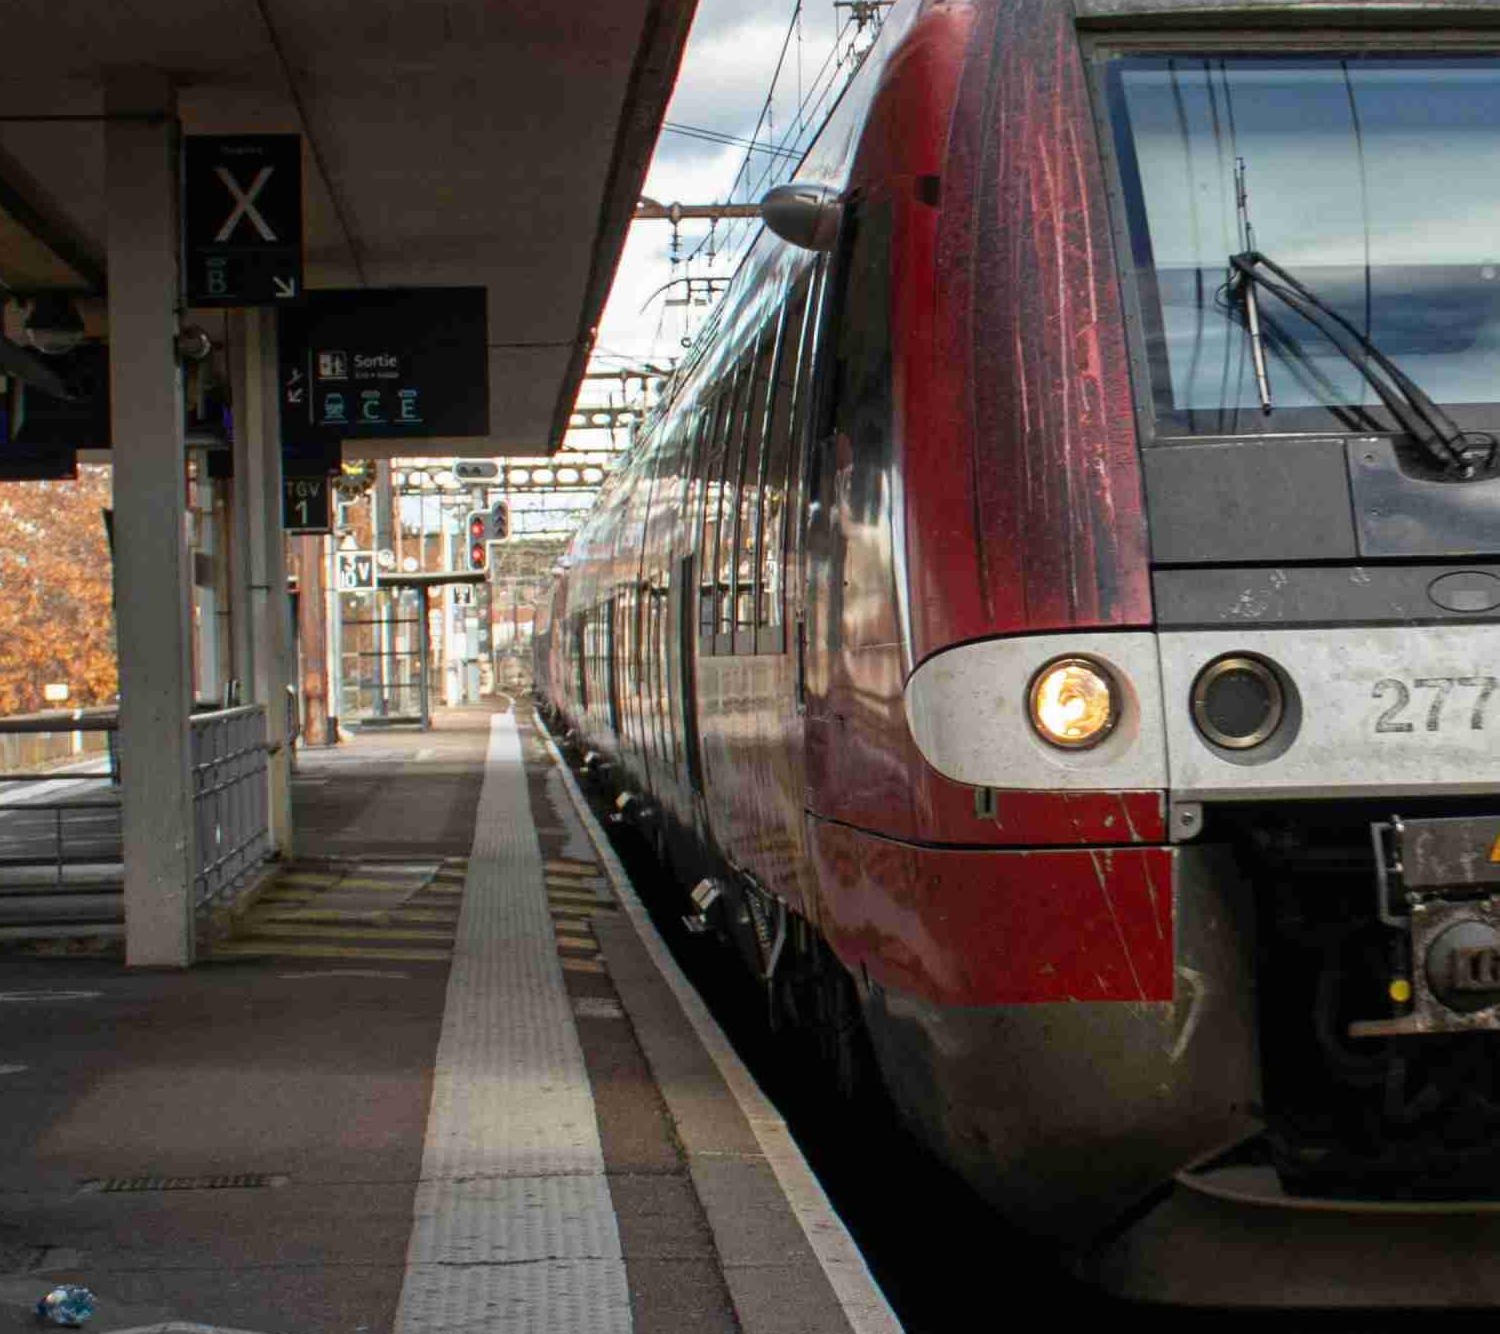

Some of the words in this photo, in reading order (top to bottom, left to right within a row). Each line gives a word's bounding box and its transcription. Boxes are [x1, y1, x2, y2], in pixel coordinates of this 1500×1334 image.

[213, 165, 278, 242] X
[353, 353, 397, 368] Sortie
[362, 400, 381, 420] C
[401, 399, 417, 419] E
[286, 480, 320, 498] TGV
